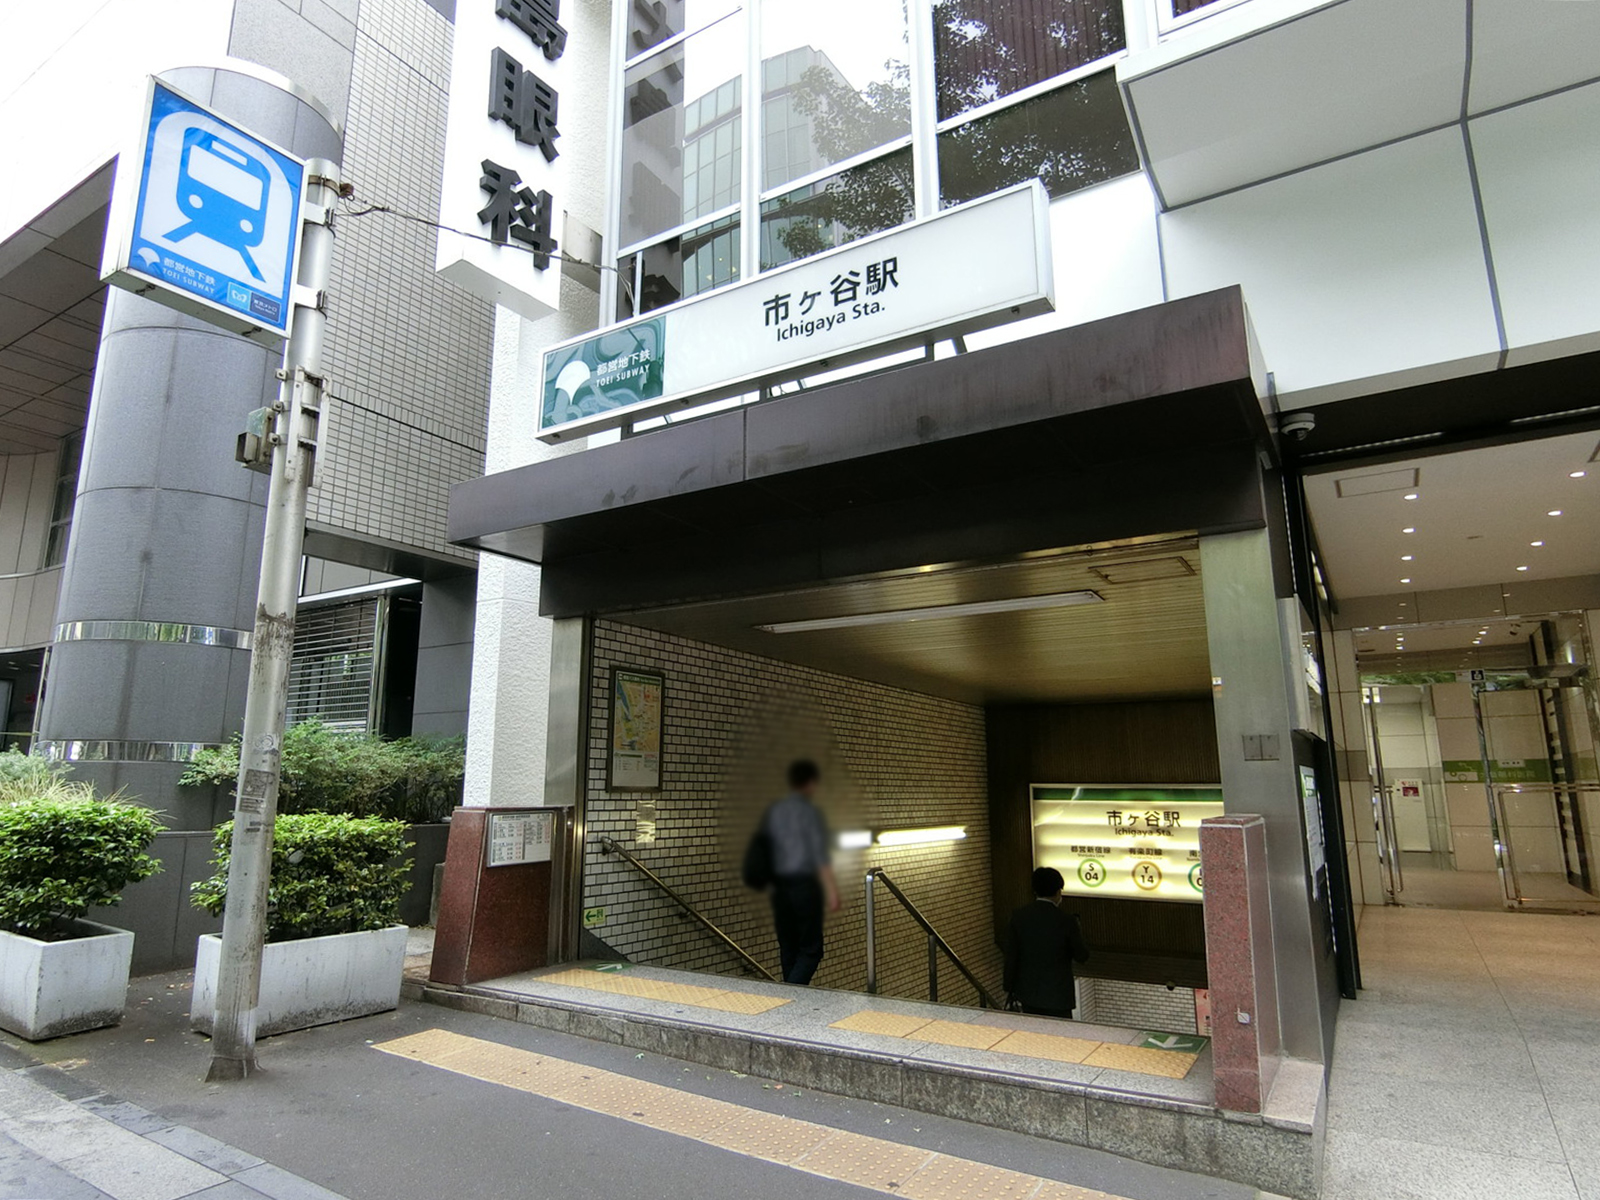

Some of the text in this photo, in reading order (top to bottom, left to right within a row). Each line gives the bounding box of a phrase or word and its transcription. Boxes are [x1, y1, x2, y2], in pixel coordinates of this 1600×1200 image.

[163, 257, 216, 286] 都営地下鉄
[162, 267, 216, 295] TOEI SUBWAY
[777, 301, 886, 341] Ichigaya Sta.
[596, 349, 651, 376] 都営地下鉄
[596, 364, 650, 388] TOEI SUBWAY
[1115, 828, 1174, 838] Ichigaya Sta.
[1088, 863, 1095, 871] S
[1143, 866, 1150, 874] Y
[1084, 872, 1099, 881] 04
[1141, 875, 1154, 884] 14
